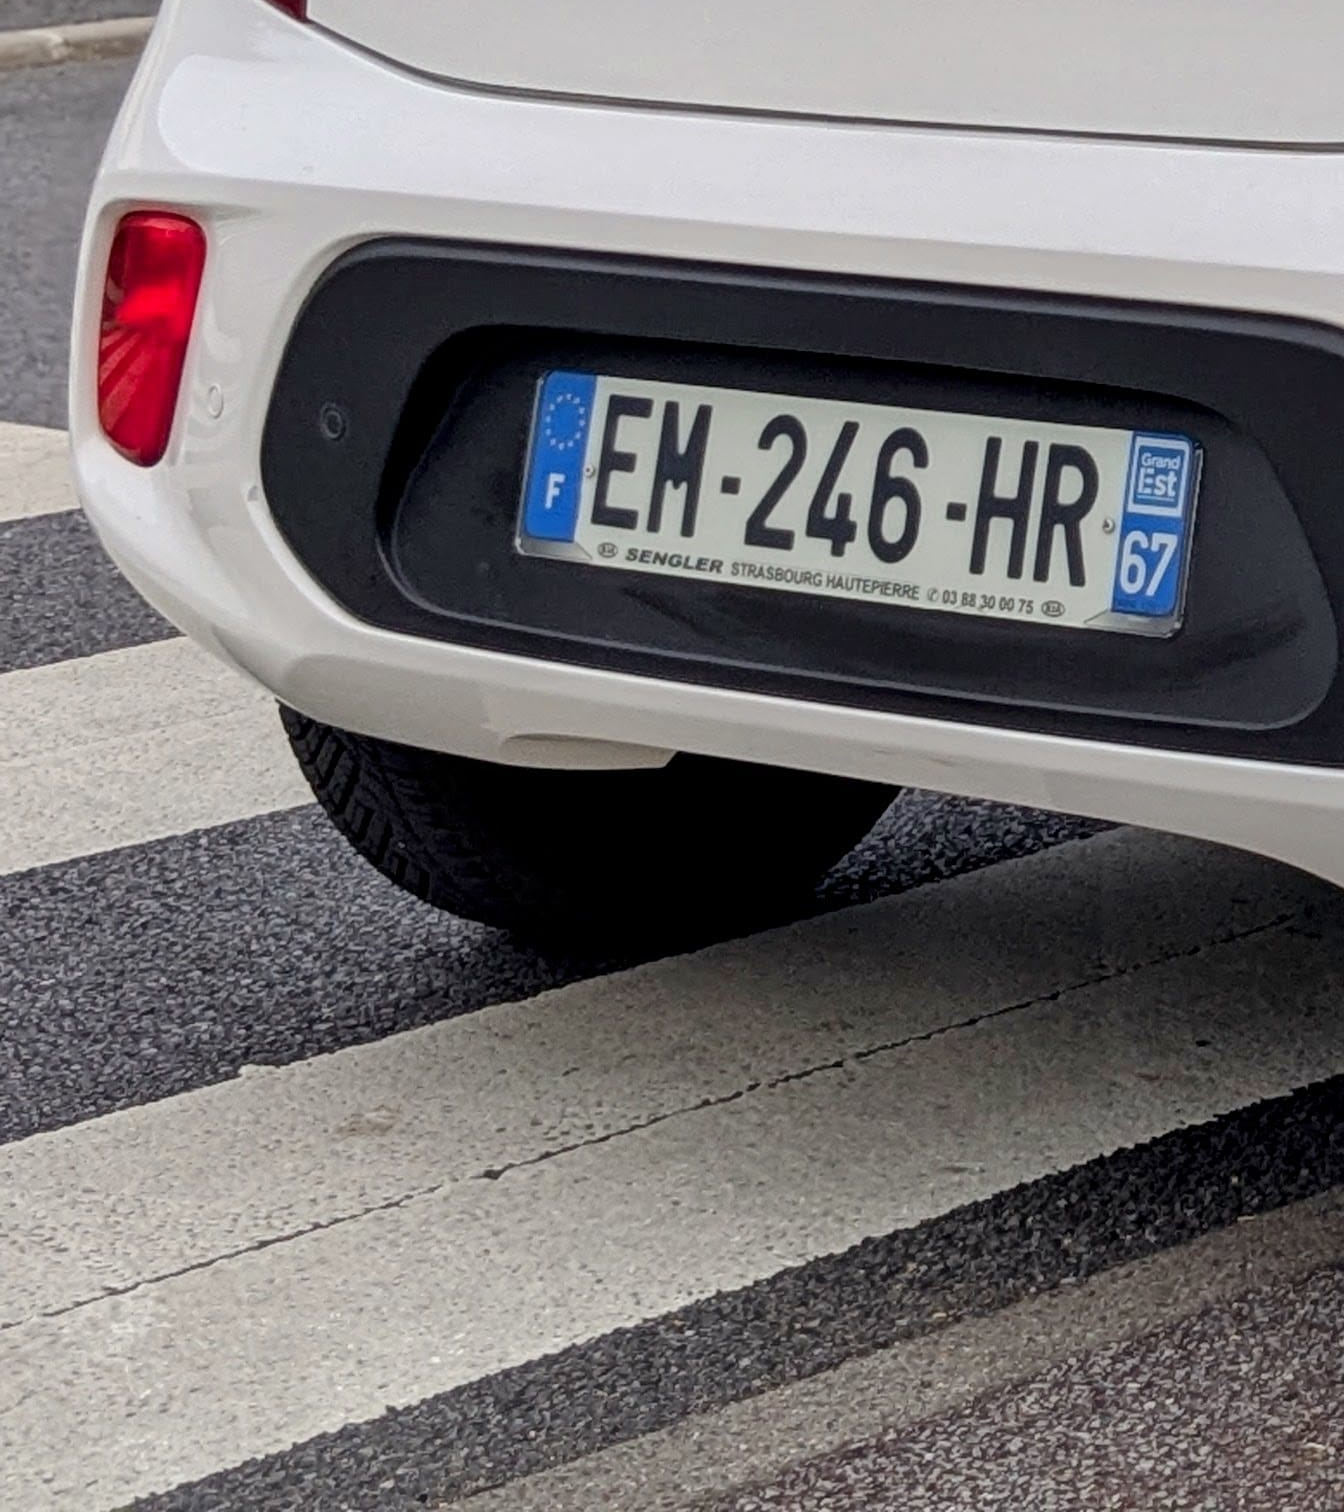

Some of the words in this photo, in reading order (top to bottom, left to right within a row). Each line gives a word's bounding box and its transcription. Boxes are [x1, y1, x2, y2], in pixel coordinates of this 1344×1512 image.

[1137, 467, 1178, 498] Est
[1141, 452, 1181, 470] Grand
[544, 472, 566, 510] F
[590, 394, 1100, 587] EM-246-HR
[625, 547, 724, 574] SENGLER
[730, 562, 823, 588] STRASBOURG
[825, 574, 920, 601] HAUTEPIERRE
[942, 590, 957, 606] 03
[980, 594, 996, 611] 30
[1018, 598, 1034, 614] 75
[1119, 530, 1179, 596] 67
